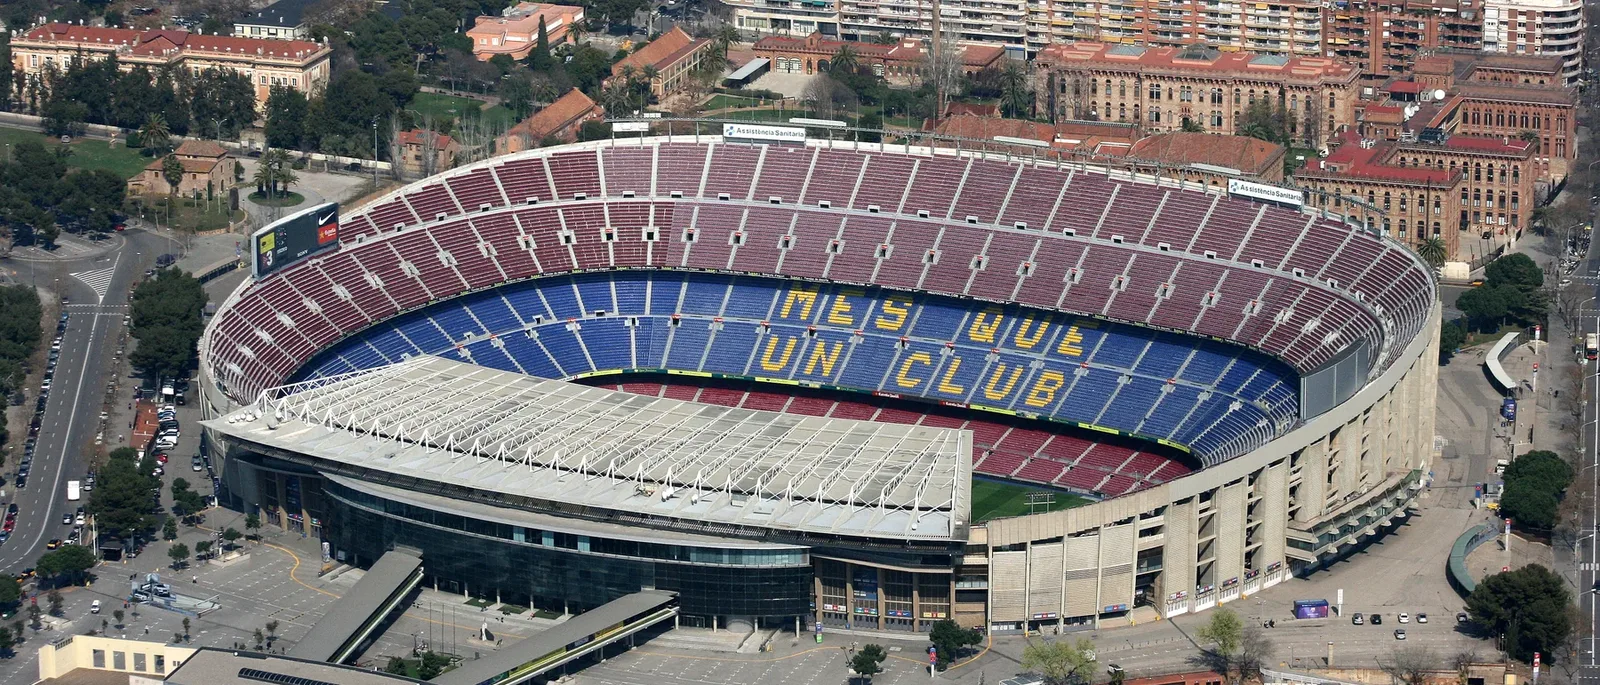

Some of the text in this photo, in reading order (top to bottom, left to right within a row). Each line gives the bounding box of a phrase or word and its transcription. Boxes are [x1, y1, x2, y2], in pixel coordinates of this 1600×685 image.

[266, 250, 273, 266] 3
[297, 249, 309, 257] SONY
[968, 307, 1099, 356] QUE
[761, 334, 1065, 408] UN CLUB
